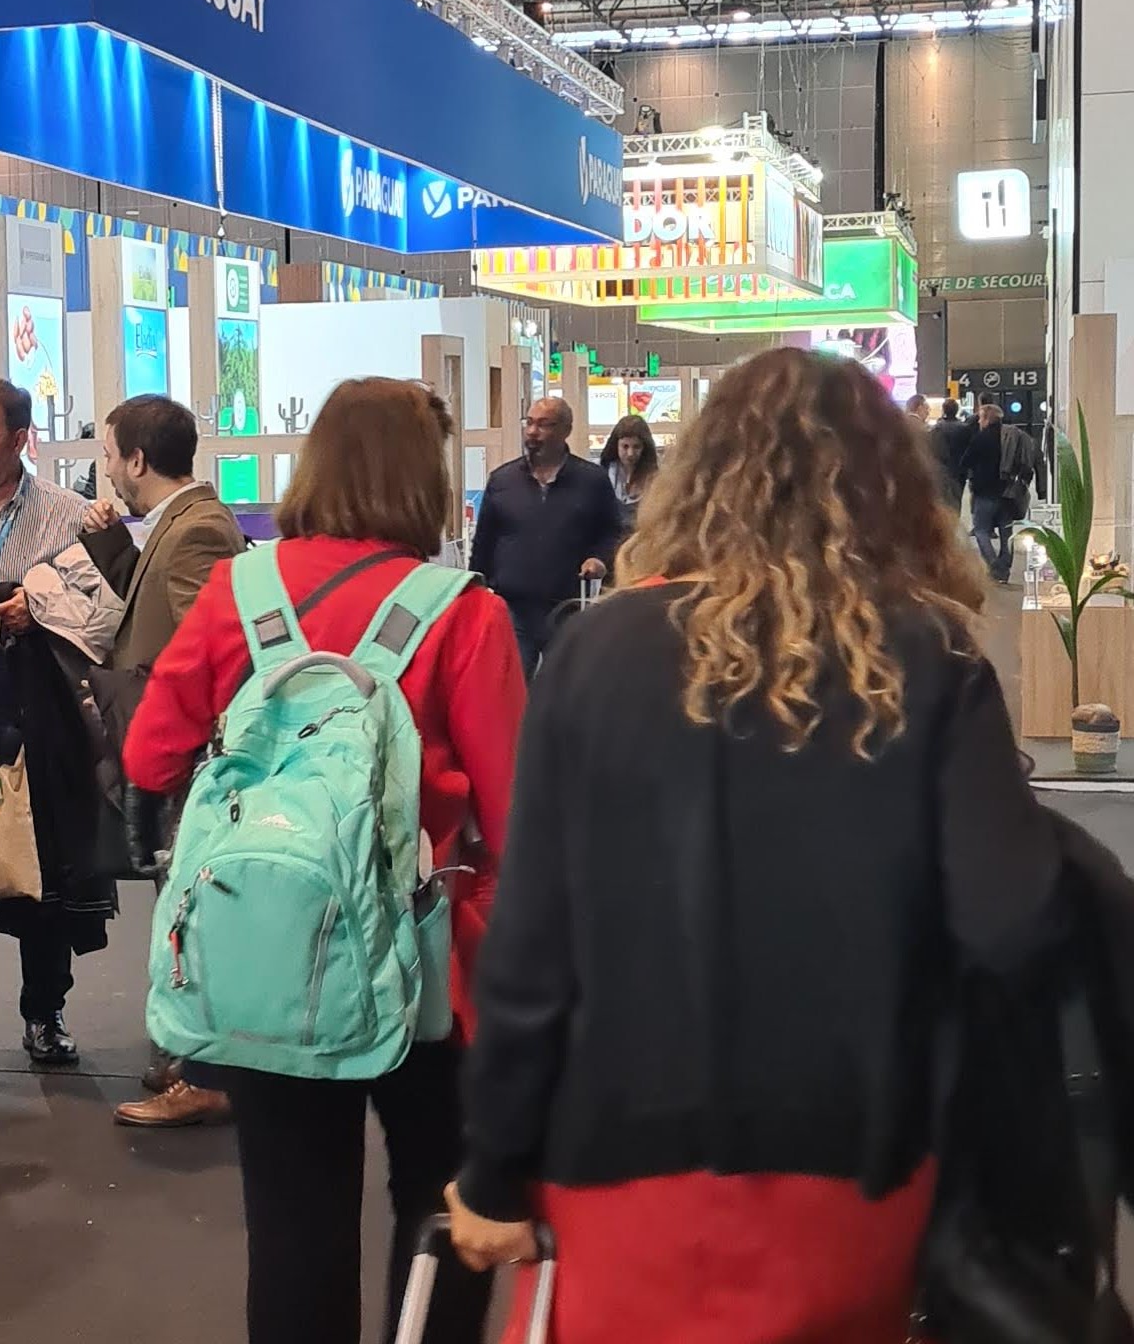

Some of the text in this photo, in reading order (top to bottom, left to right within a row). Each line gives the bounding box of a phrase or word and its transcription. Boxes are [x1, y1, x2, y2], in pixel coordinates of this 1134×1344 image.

[588, 152, 623, 206] PARAGUA
[955, 276, 977, 290] DE
[1013, 371, 1038, 386] H3
